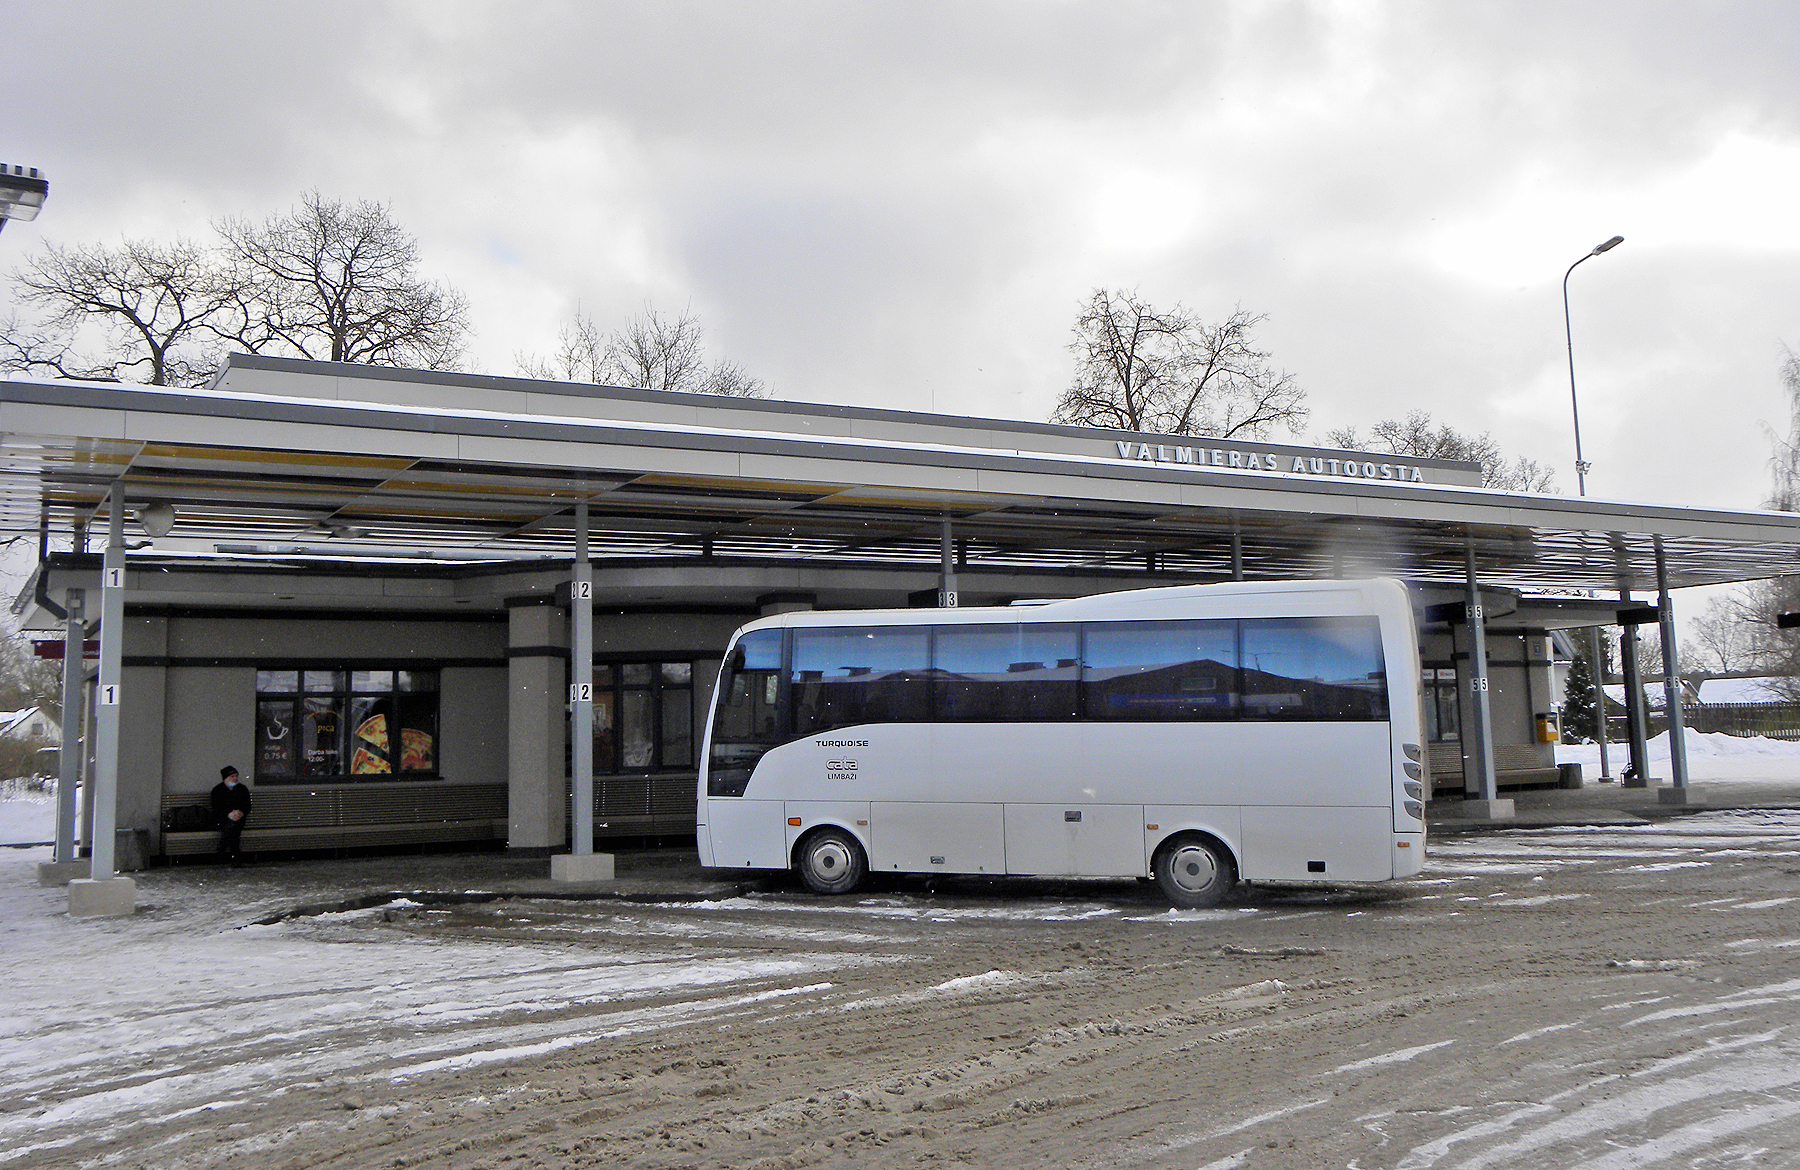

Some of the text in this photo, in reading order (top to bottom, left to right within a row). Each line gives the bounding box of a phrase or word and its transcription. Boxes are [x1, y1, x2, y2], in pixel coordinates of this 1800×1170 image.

[1116, 440, 1424, 482] VALMIERAS AUTOOSTA
[110, 569, 119, 587] 1
[581, 582, 589, 598] 2
[949, 592, 955, 606] 3
[106, 686, 114, 704] 1
[581, 684, 589, 700] 2
[815, 740, 869, 748] TURQUOISE
[826, 755, 858, 771] cata
